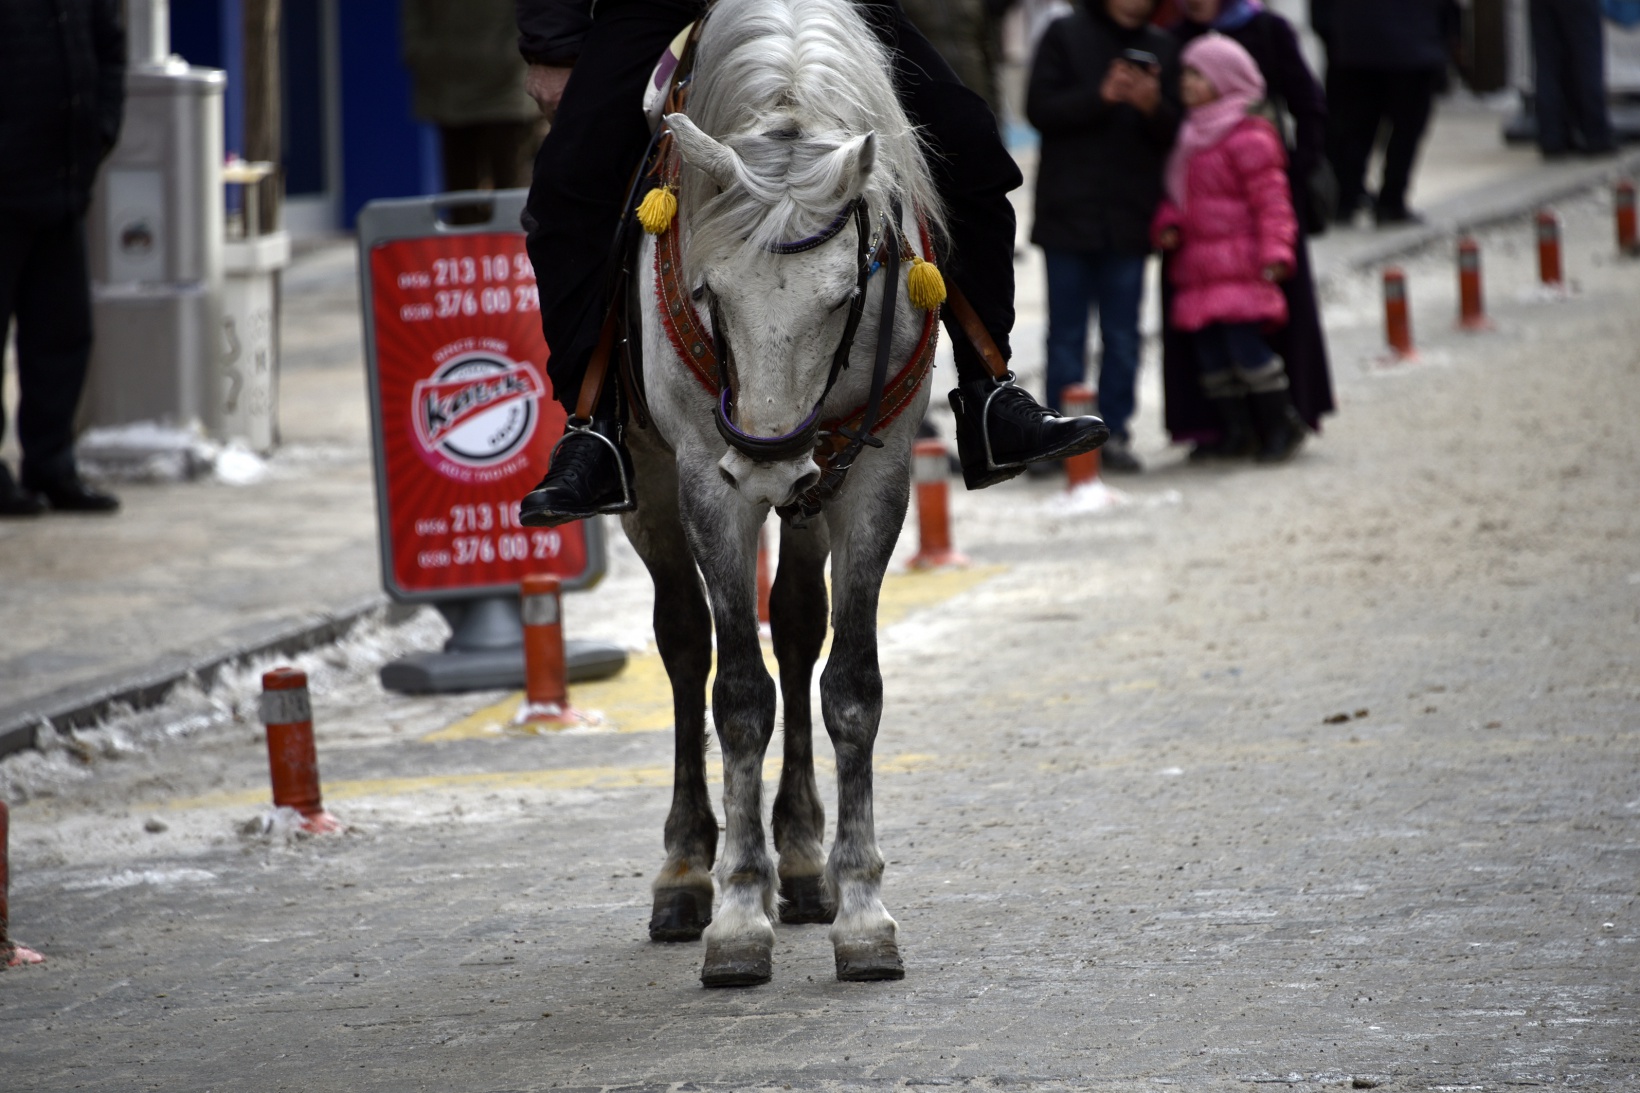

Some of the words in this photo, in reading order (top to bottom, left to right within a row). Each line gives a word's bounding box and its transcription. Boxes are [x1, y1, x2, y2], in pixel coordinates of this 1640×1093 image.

[433, 256, 476, 286] 213
[480, 254, 509, 282] 10
[434, 288, 477, 318] 376
[481, 286, 511, 315] 00
[514, 284, 540, 312] 29
[450, 502, 493, 532] 213
[452, 535, 495, 564] 376
[498, 532, 528, 561] 00
[531, 530, 561, 559] 29
